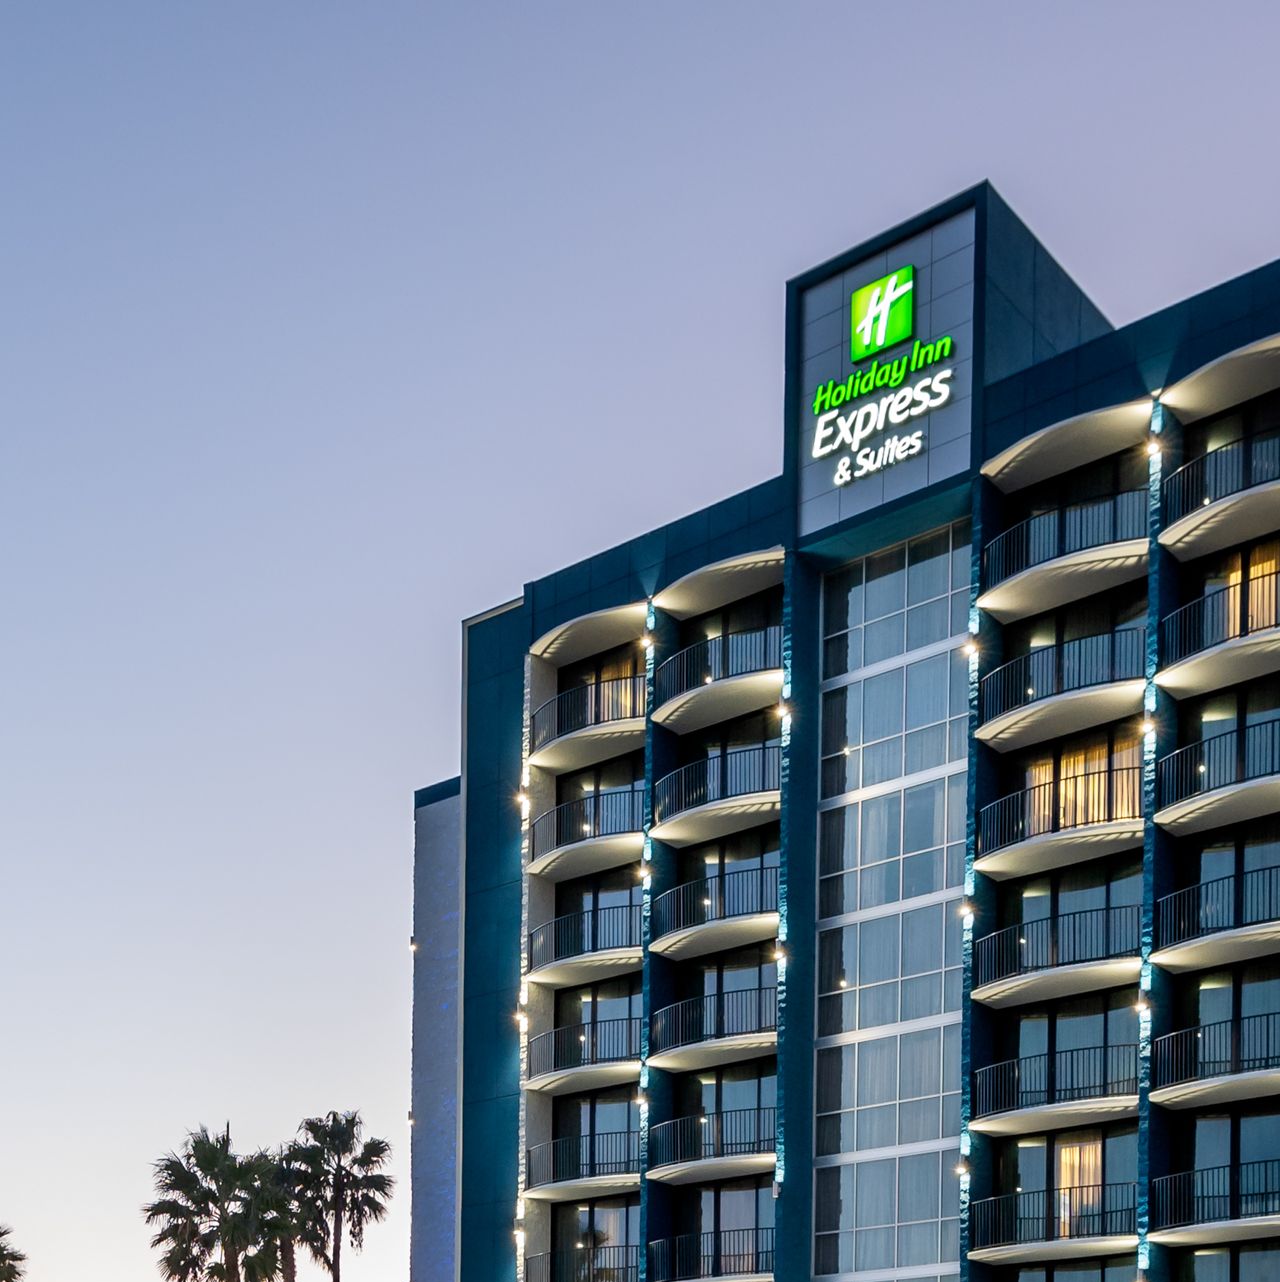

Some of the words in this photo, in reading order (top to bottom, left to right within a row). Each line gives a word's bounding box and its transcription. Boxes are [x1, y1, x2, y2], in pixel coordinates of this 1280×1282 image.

[812, 369, 952, 458] Express
[813, 355, 908, 415] Holiday
[910, 336, 952, 372] Inn
[833, 457, 851, 486] &
[854, 431, 923, 477] Suites
